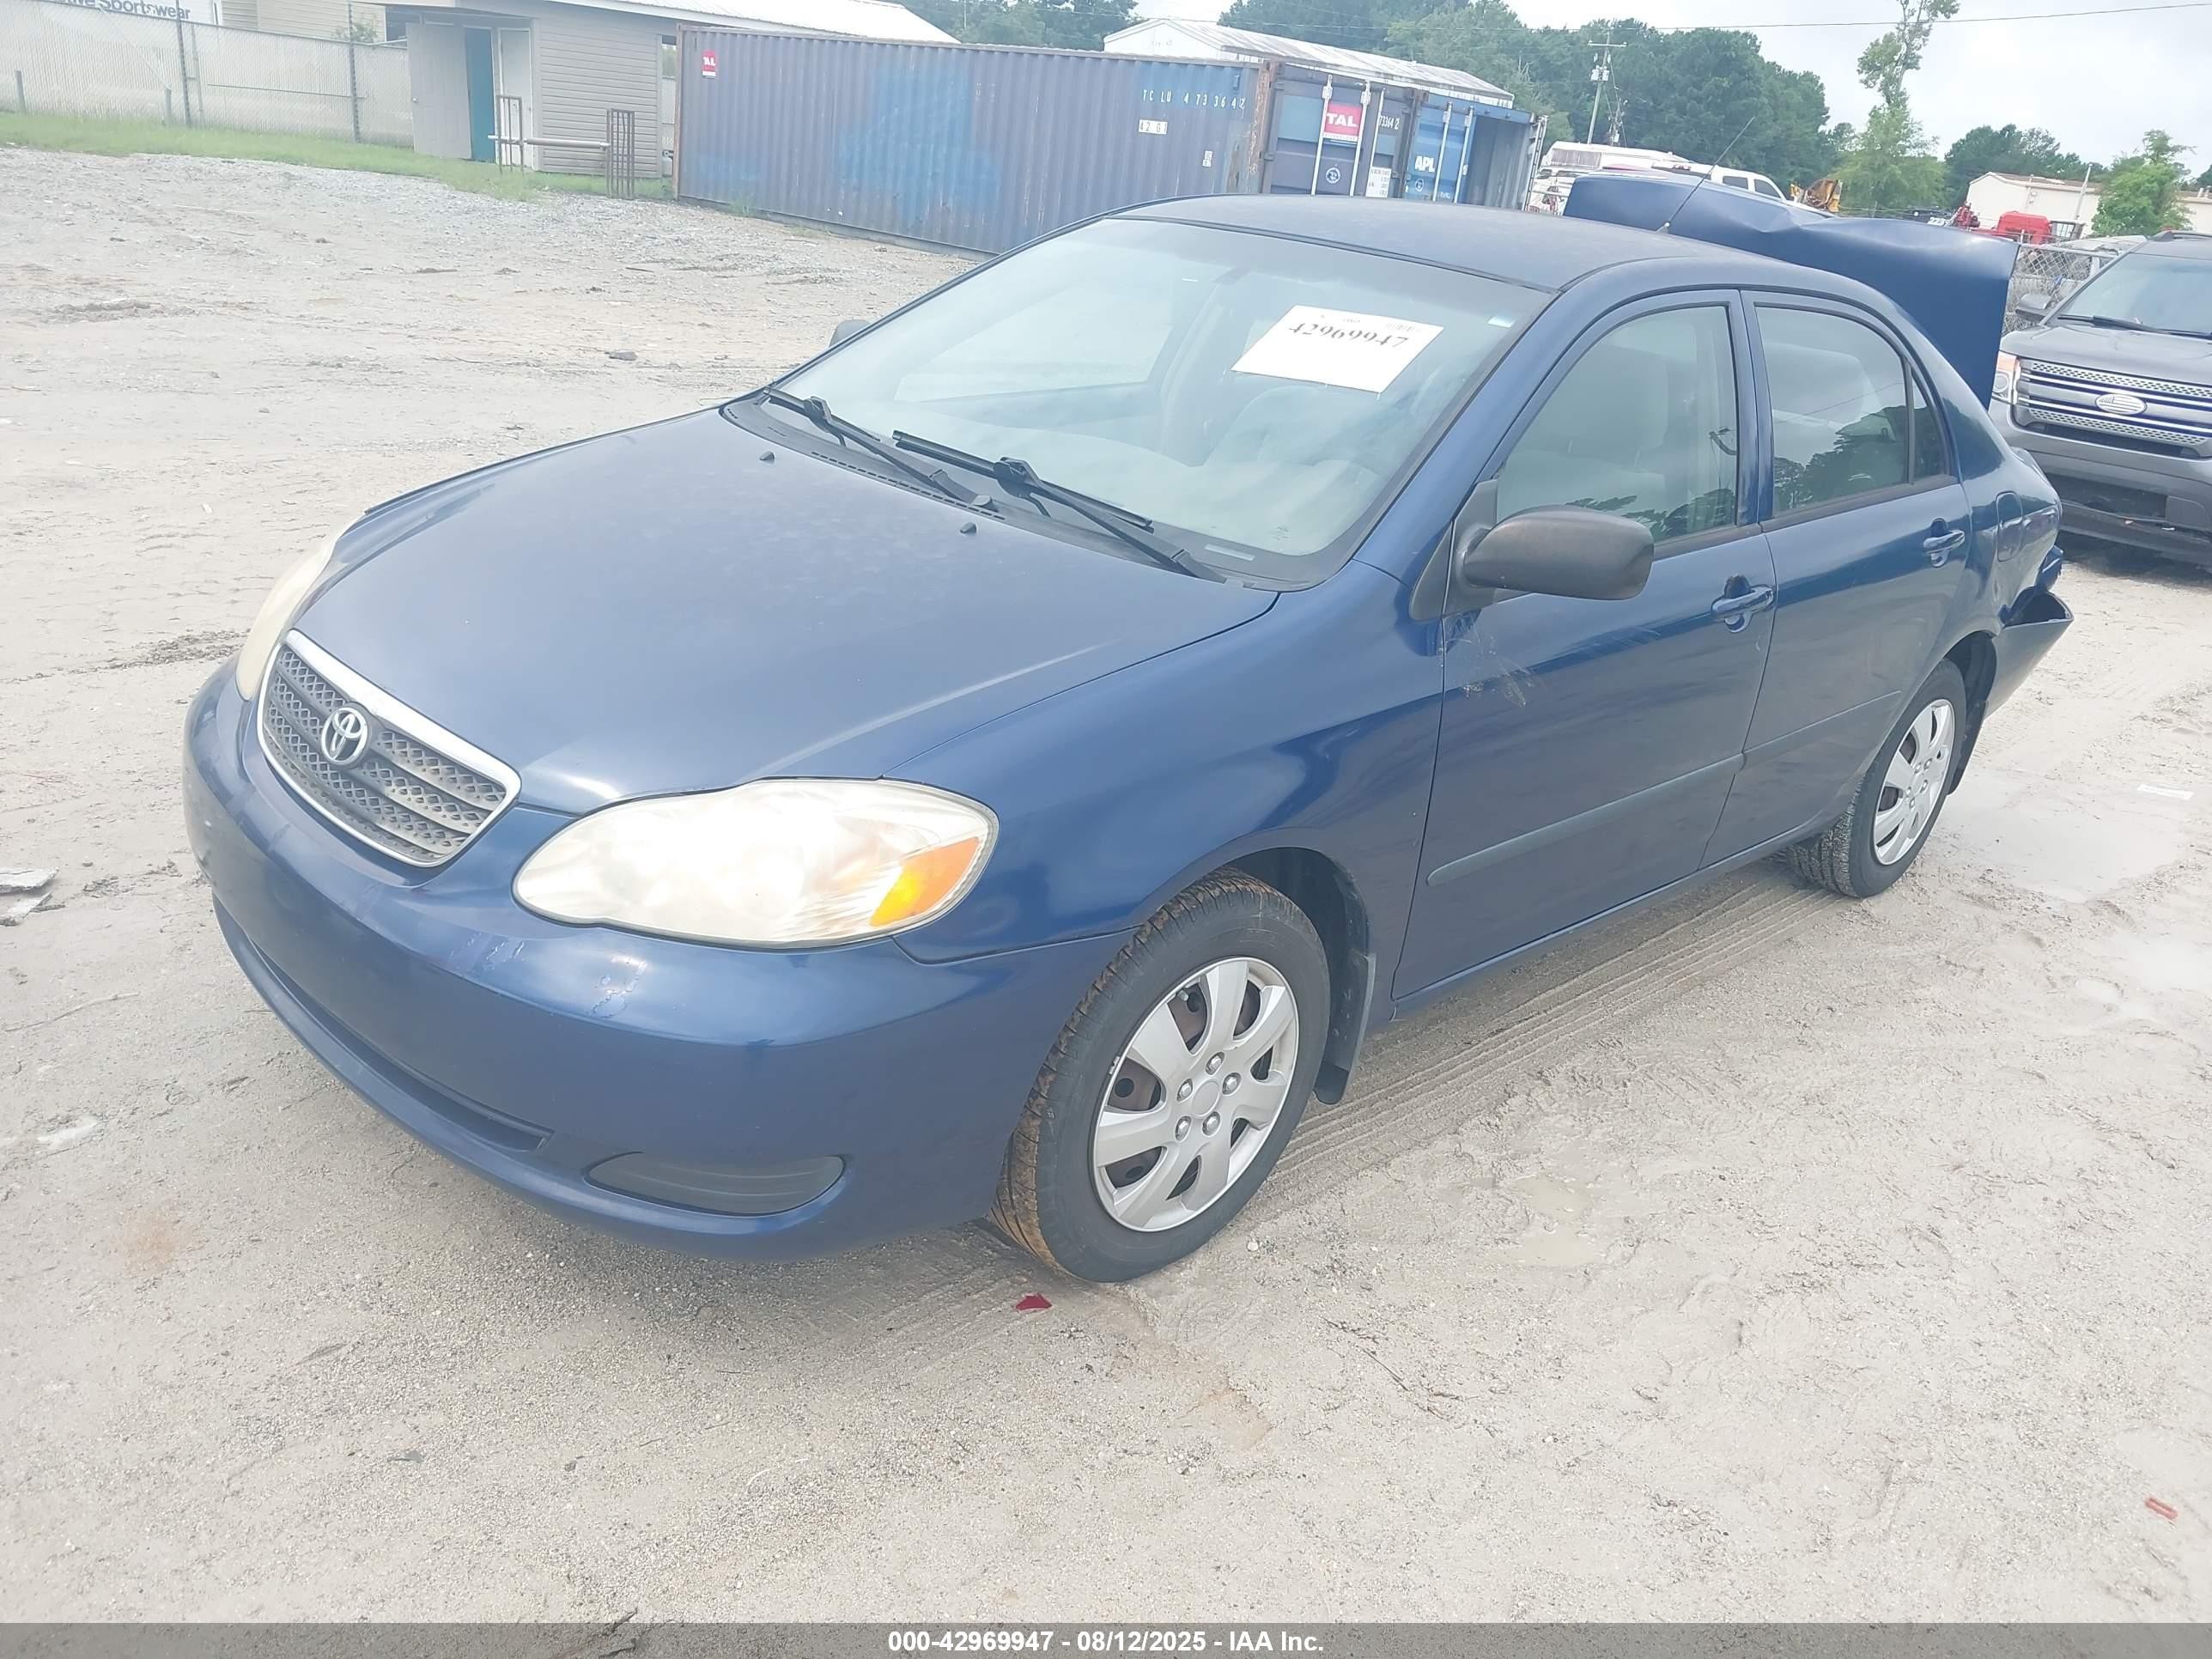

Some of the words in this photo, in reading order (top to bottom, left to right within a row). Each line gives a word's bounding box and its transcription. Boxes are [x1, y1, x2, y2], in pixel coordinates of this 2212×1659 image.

[1326, 112, 1357, 127] TAL
[1414, 155, 1435, 172] APL
[1288, 322, 1409, 348] 42969947
